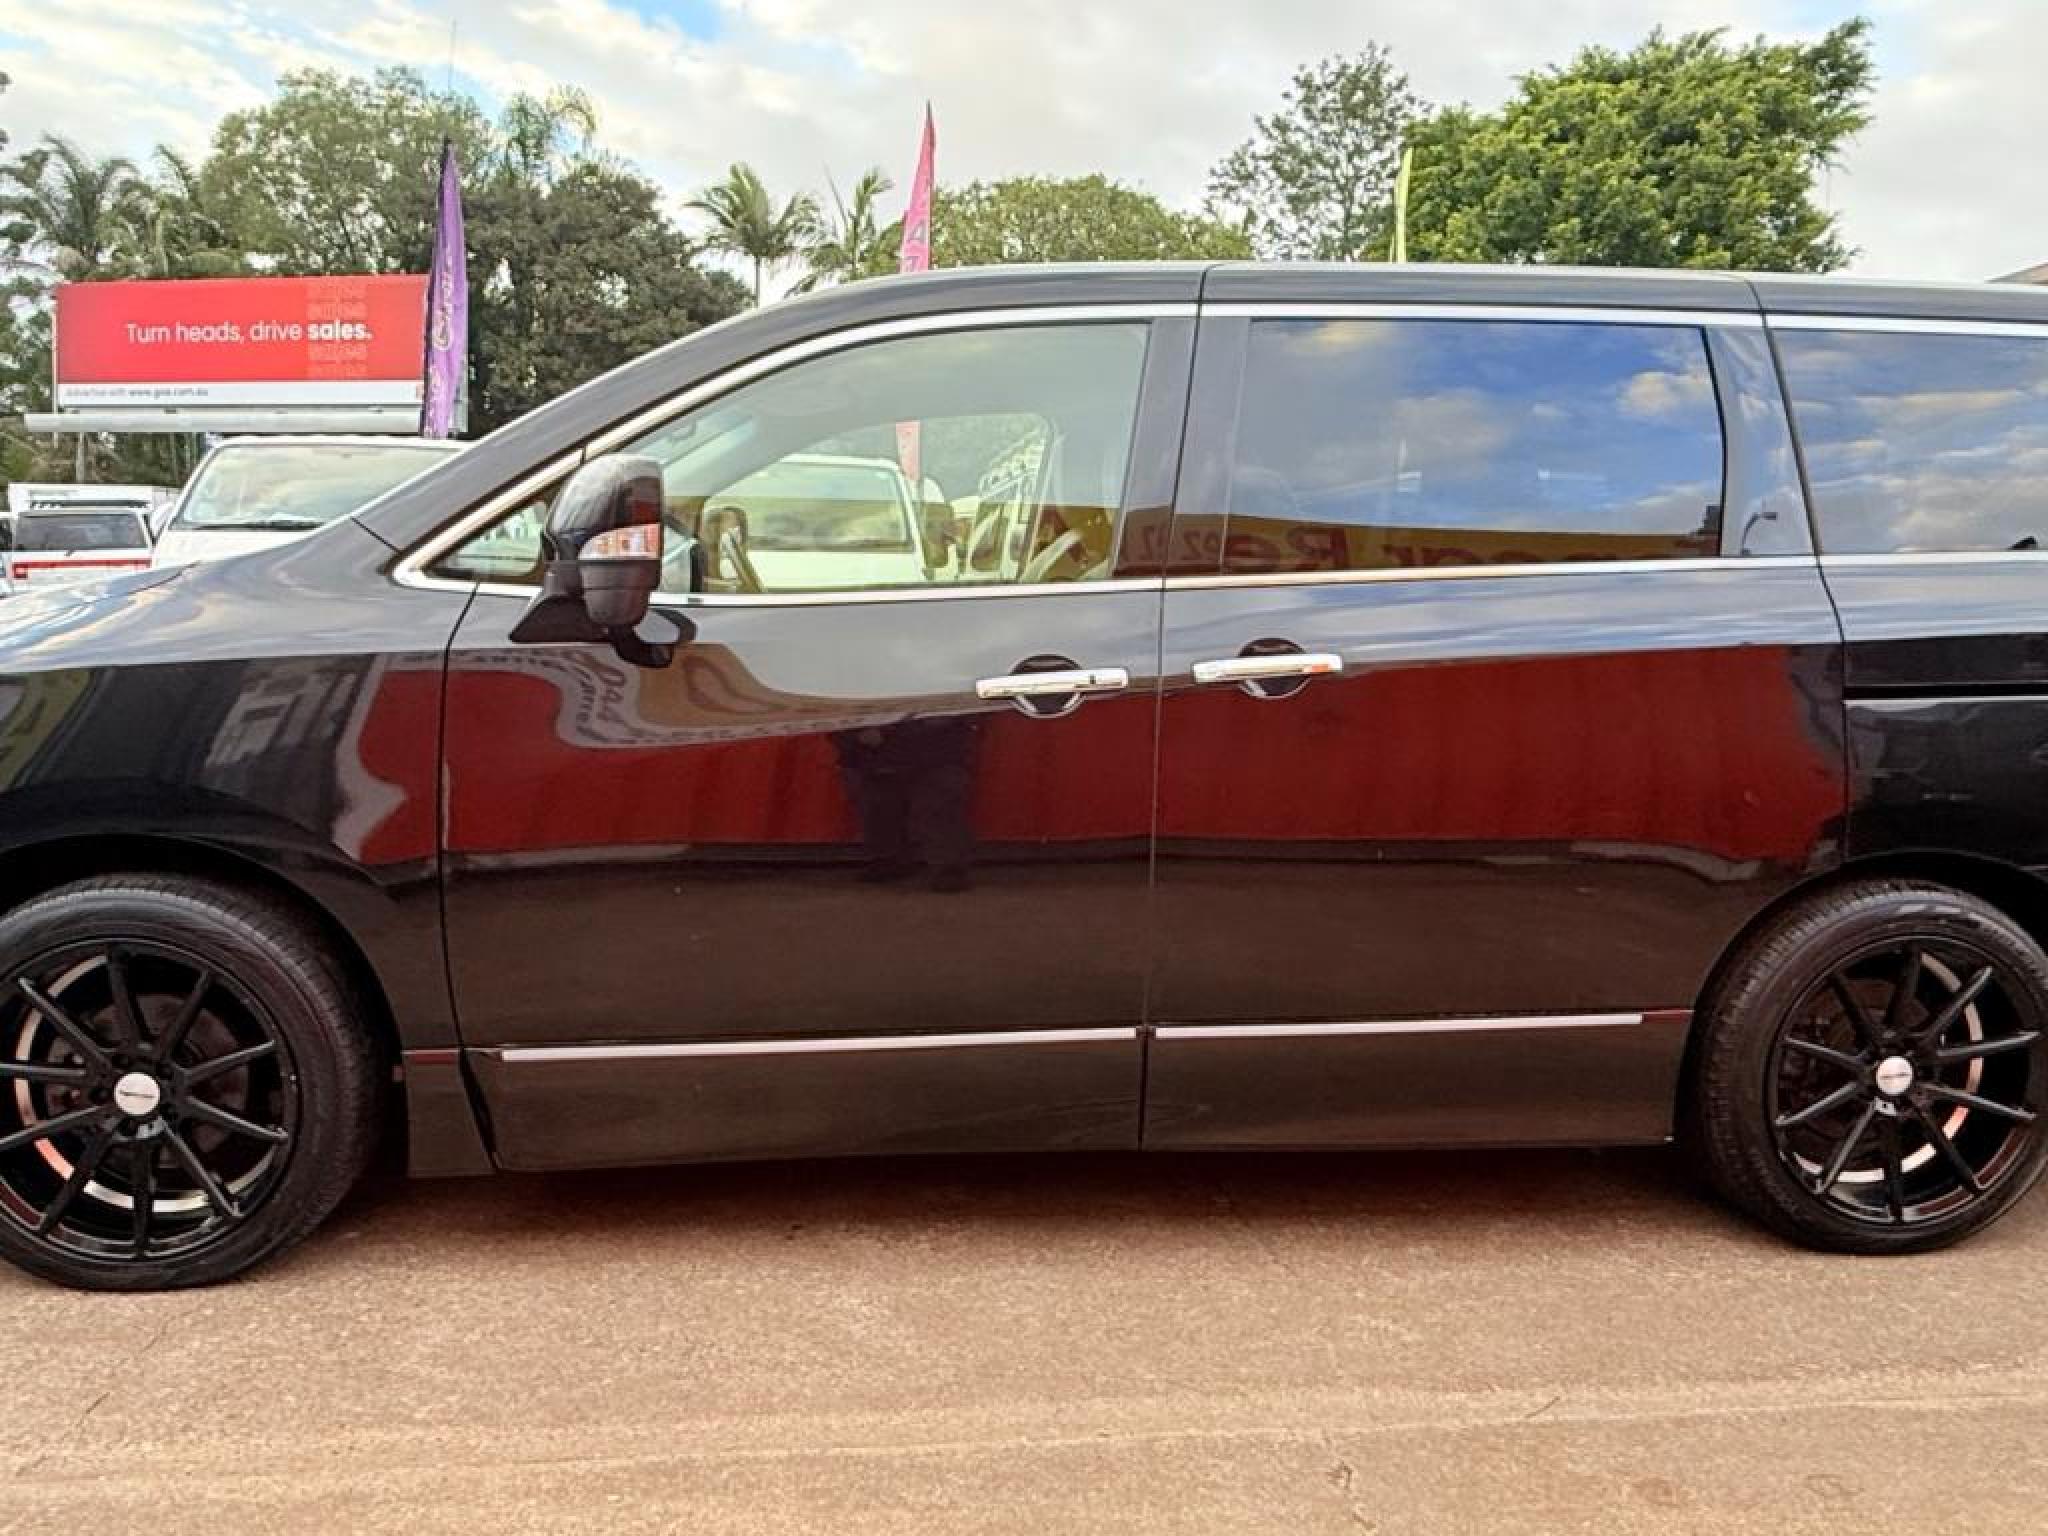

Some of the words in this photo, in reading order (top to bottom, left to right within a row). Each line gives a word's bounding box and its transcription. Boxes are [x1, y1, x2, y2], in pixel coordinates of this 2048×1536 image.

[126, 322, 170, 344] Turn
[175, 320, 244, 345] heads,
[250, 319, 301, 342] drive
[306, 318, 373, 341] sales.
